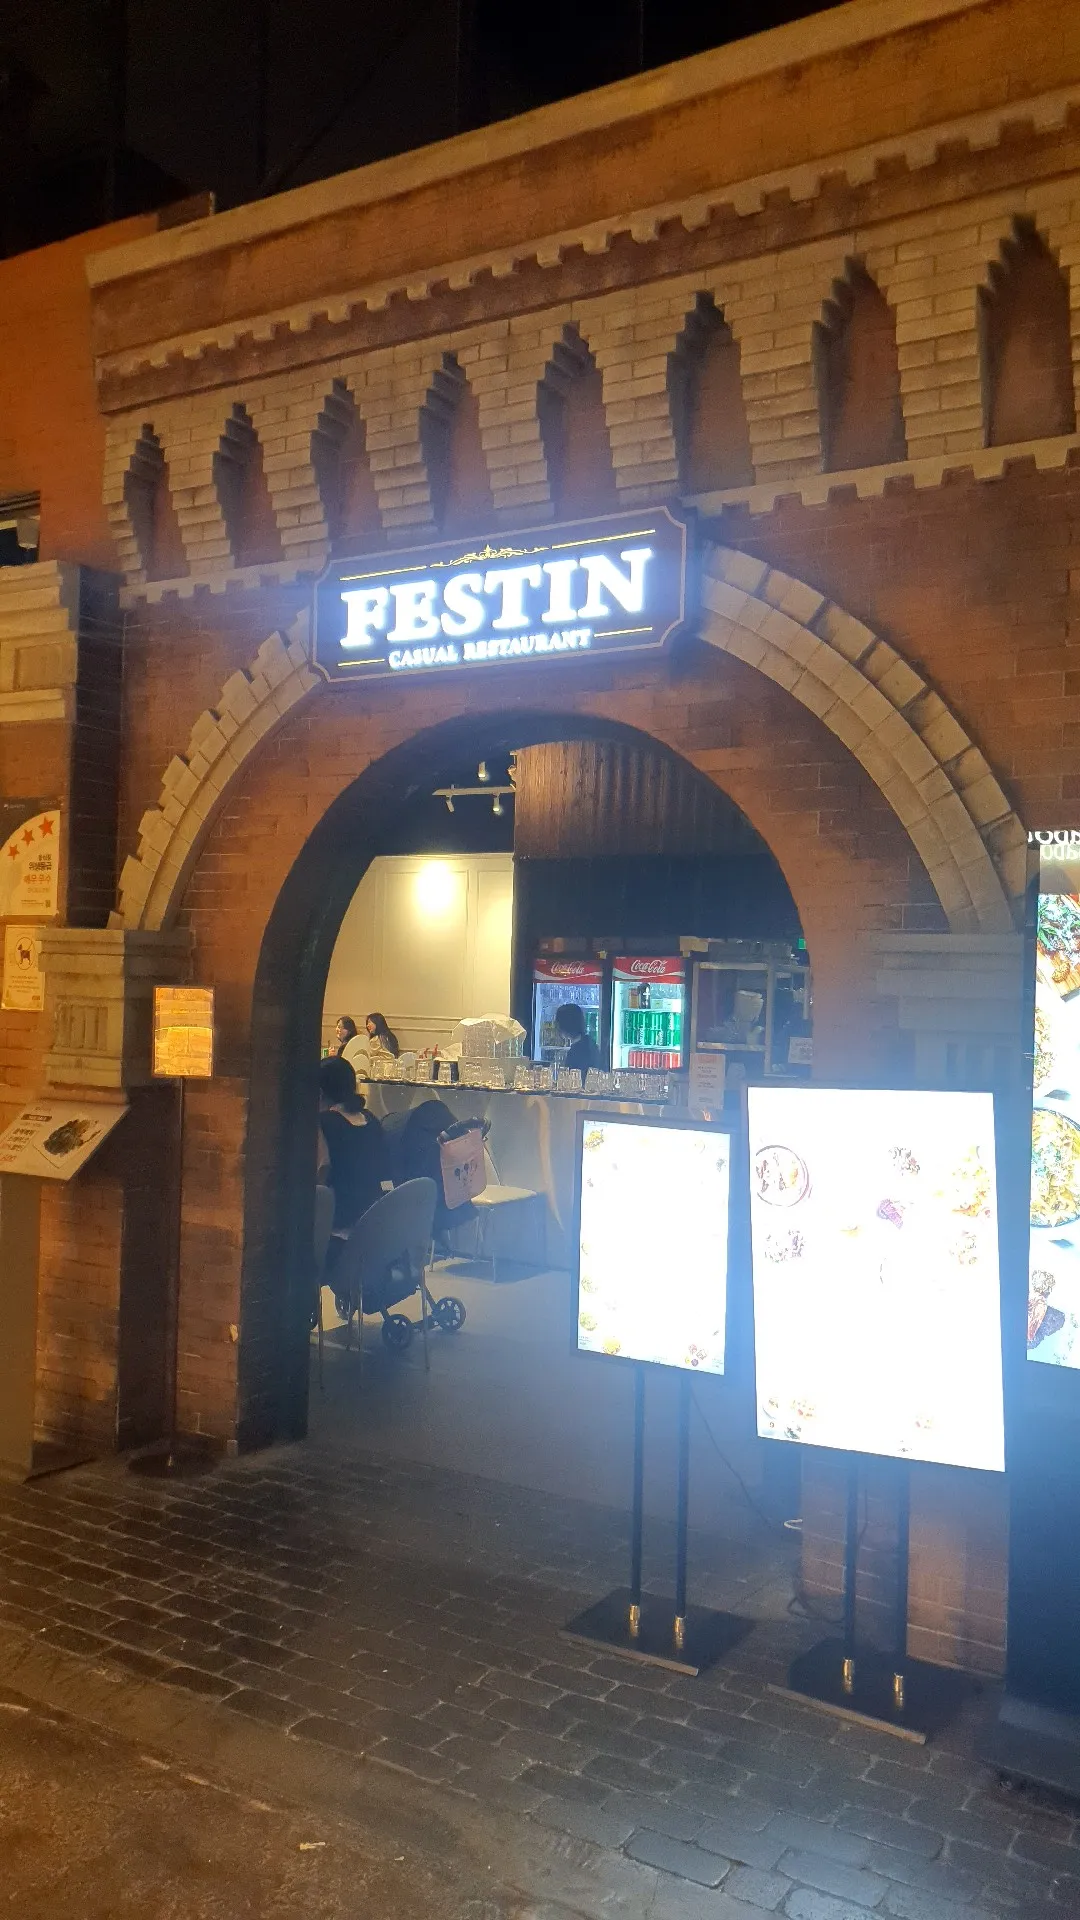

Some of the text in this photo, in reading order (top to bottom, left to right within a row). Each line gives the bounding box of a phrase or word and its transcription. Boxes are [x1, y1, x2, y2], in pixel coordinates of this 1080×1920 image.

[340, 548, 652, 648] FESTIN
[388, 629, 593, 670] CASUAL RESTAURANT
